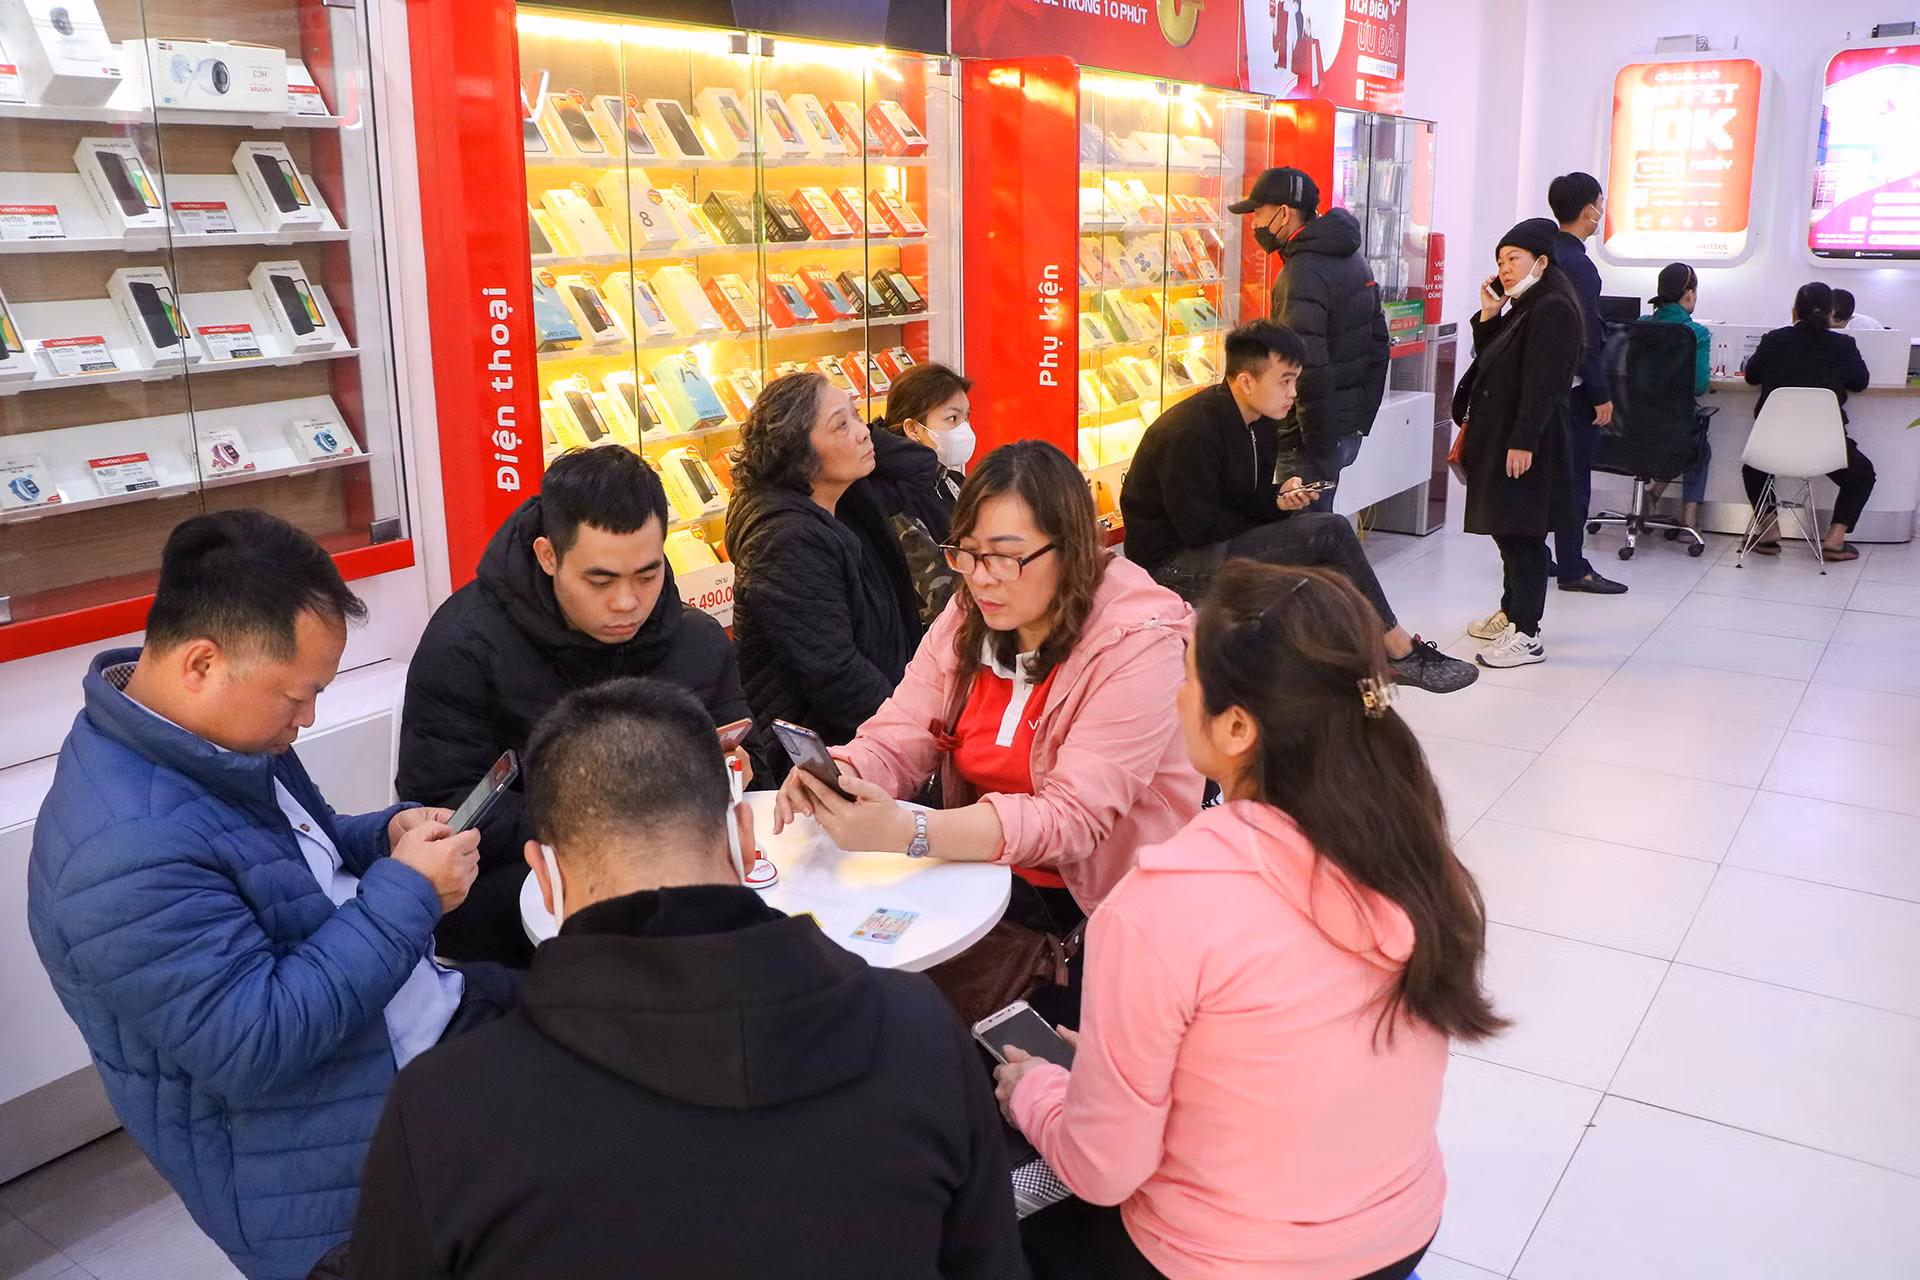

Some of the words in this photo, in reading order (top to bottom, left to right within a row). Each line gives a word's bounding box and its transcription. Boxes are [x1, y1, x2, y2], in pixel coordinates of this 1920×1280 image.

[1120, 4, 1149, 25] PHÚT
[1634, 84, 1739, 105] FFET
[1038, 264, 1064, 320] kiện
[482, 288, 514, 392] thoại
[1038, 335, 1064, 386] Phụ
[491, 406, 523, 492] Điện
